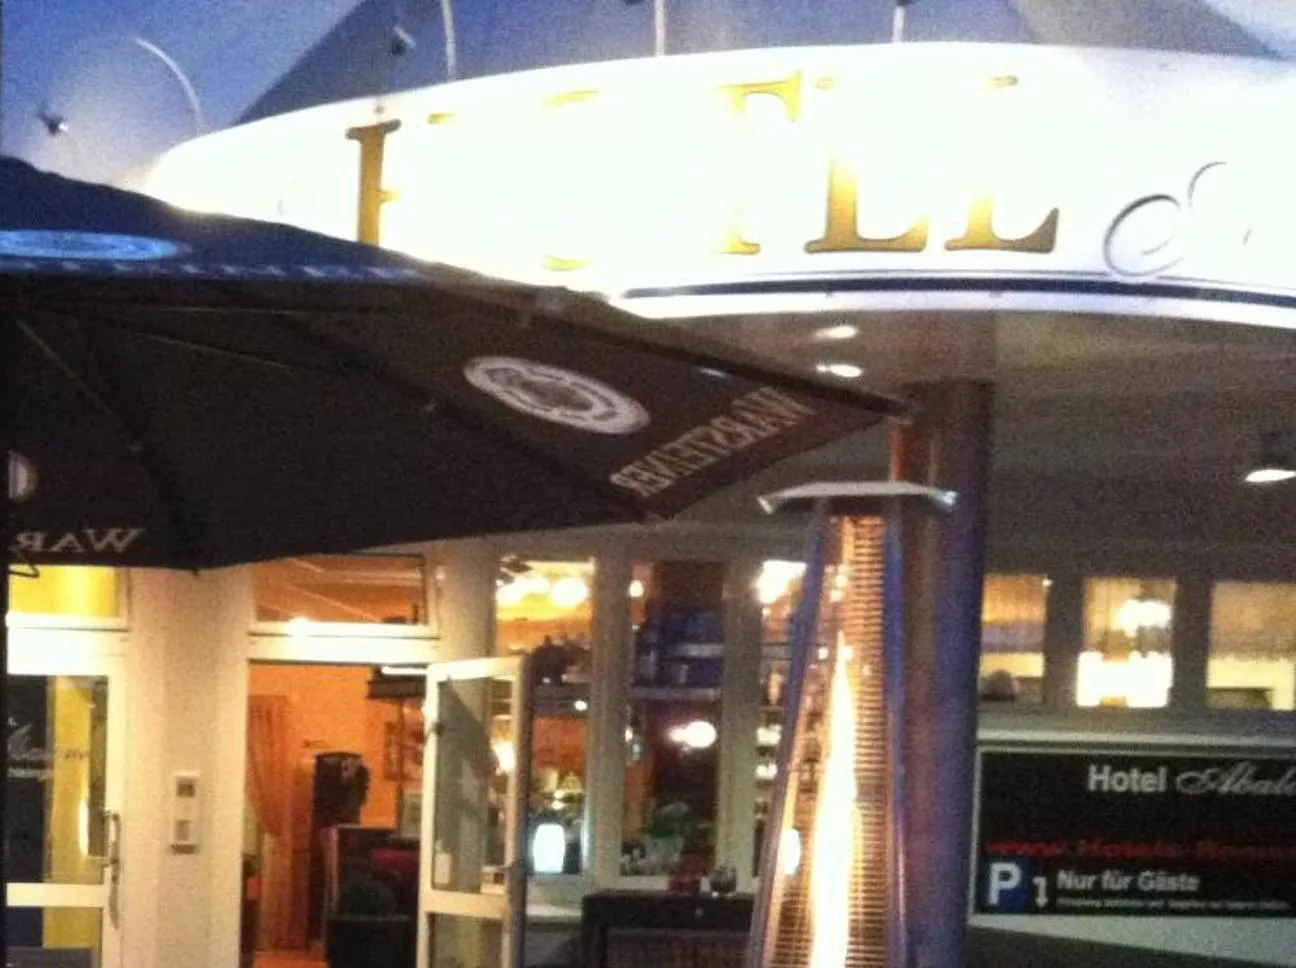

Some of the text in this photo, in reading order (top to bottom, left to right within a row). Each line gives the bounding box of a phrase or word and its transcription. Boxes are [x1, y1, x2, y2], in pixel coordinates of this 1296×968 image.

[1088, 763, 1167, 793] Hotel
[988, 862, 1022, 905] P
[1057, 869, 1096, 891] Nur
[1101, 868, 1134, 891] für
